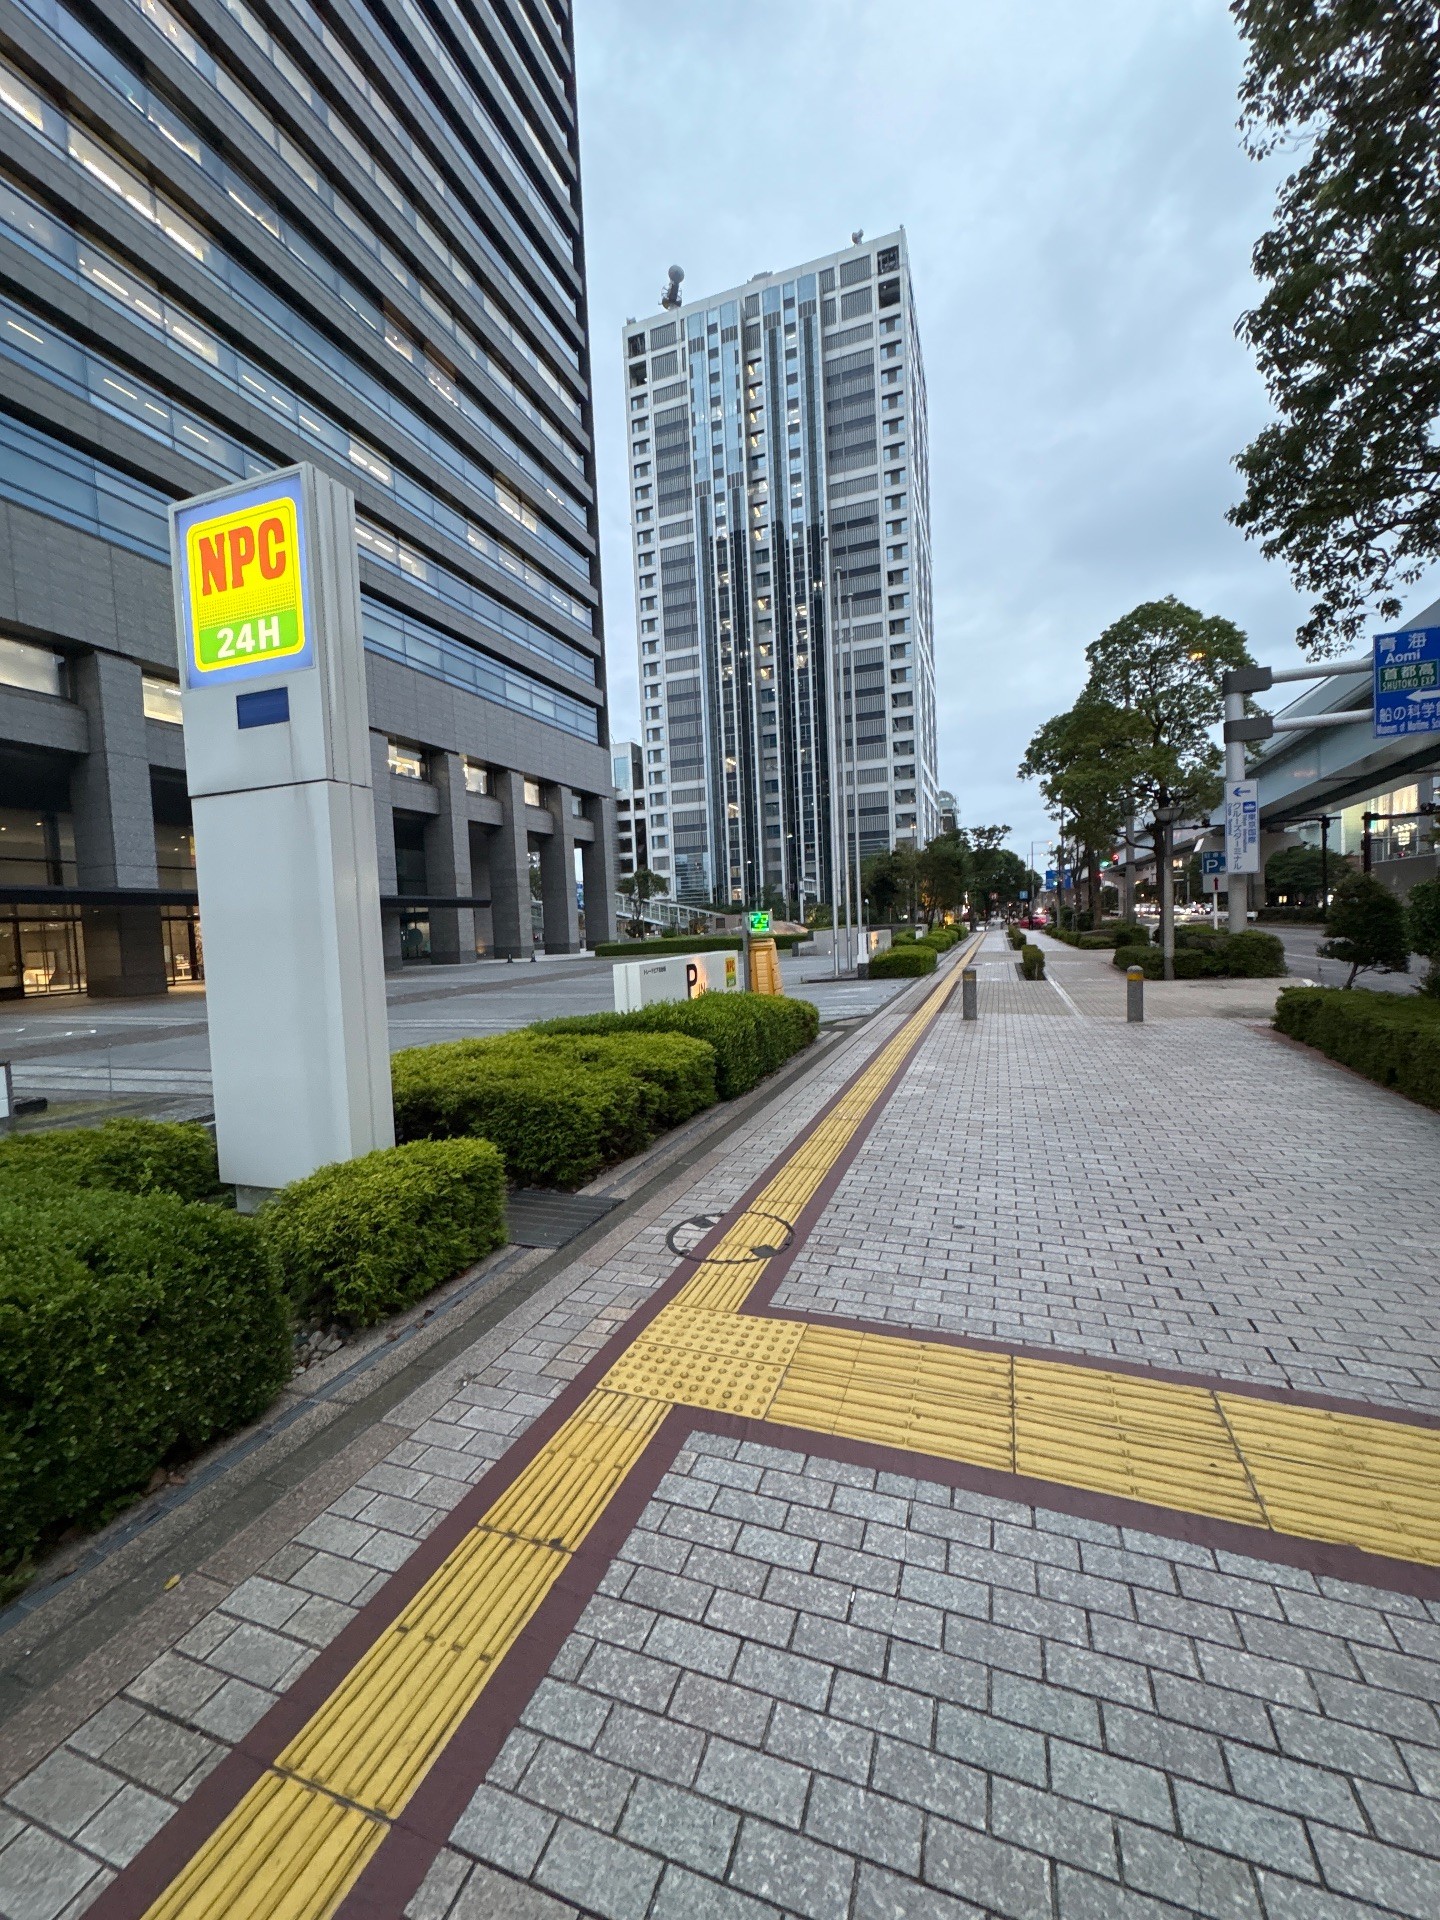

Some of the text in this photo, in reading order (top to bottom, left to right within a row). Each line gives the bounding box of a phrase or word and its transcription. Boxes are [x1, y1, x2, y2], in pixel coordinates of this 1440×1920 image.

[199, 518, 286, 596] NPC
[217, 615, 281, 658] 24H
[1385, 650, 1420, 664] Aomi
[1382, 675, 1435, 691] SHUTOKO EXP
[1384, 663, 1434, 681] 首都高
[1233, 802, 1242, 870] クルーズターミナル
[1206, 859, 1218, 873] P
[686, 963, 698, 999] P
